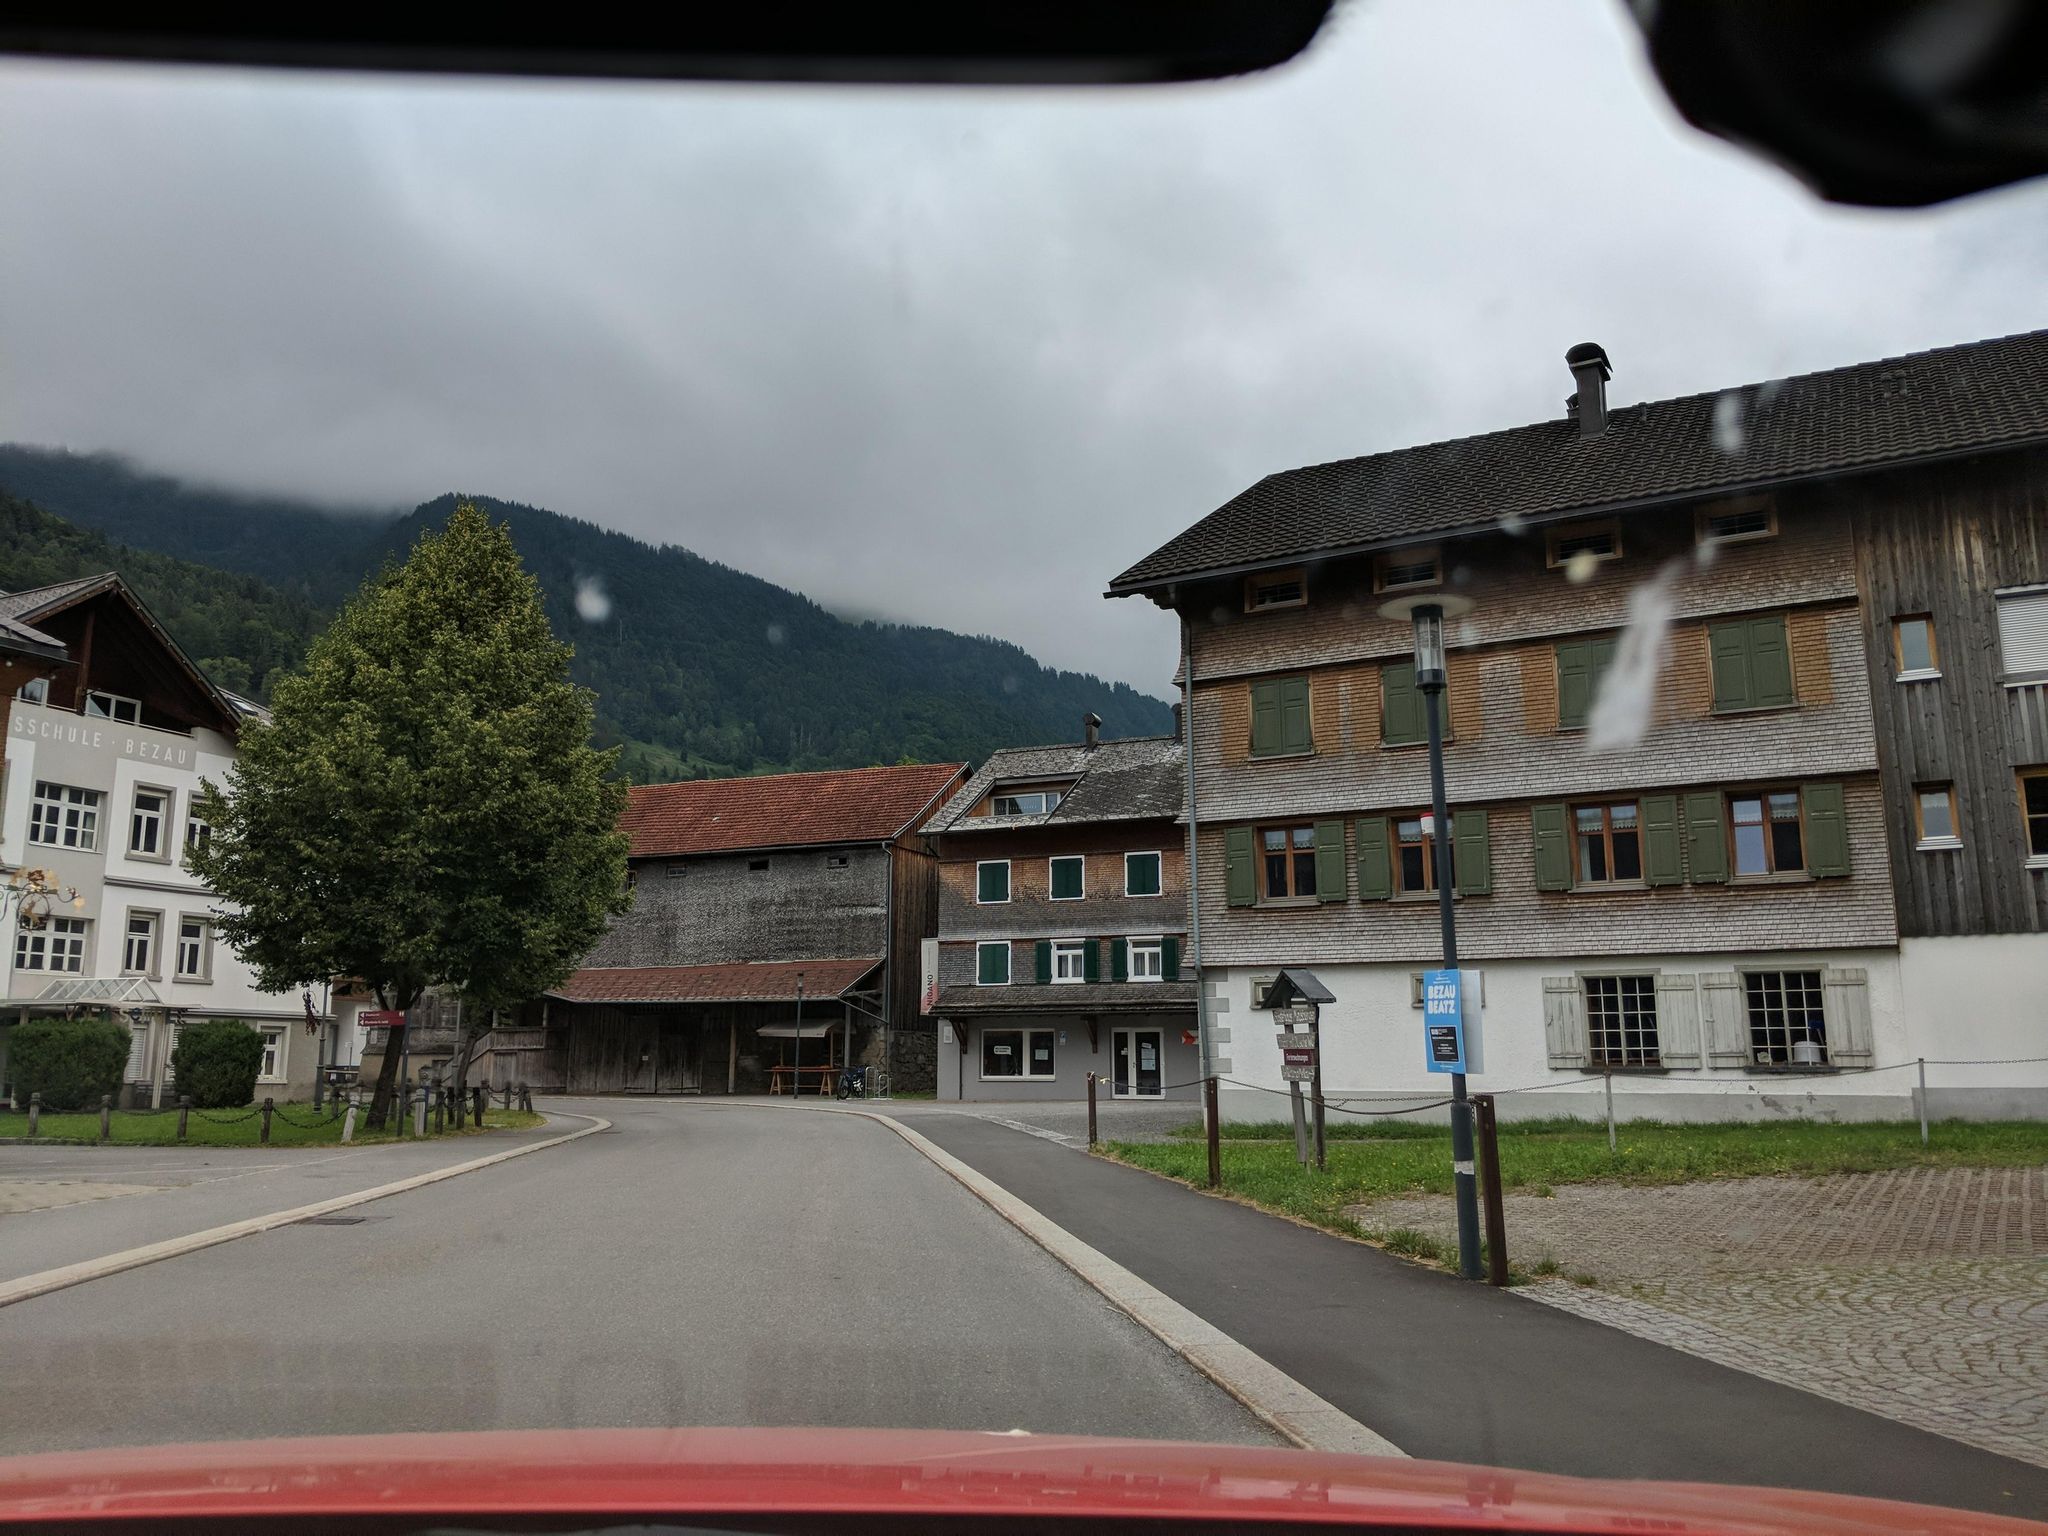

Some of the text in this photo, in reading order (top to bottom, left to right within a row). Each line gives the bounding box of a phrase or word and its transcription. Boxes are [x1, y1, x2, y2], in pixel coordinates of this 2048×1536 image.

[125, 738, 187, 765] BEZAU
[926, 974, 934, 1006] NIGANO
[1427, 984, 1456, 999] BEZAU
[1427, 999, 1456, 1015] BEATZ
